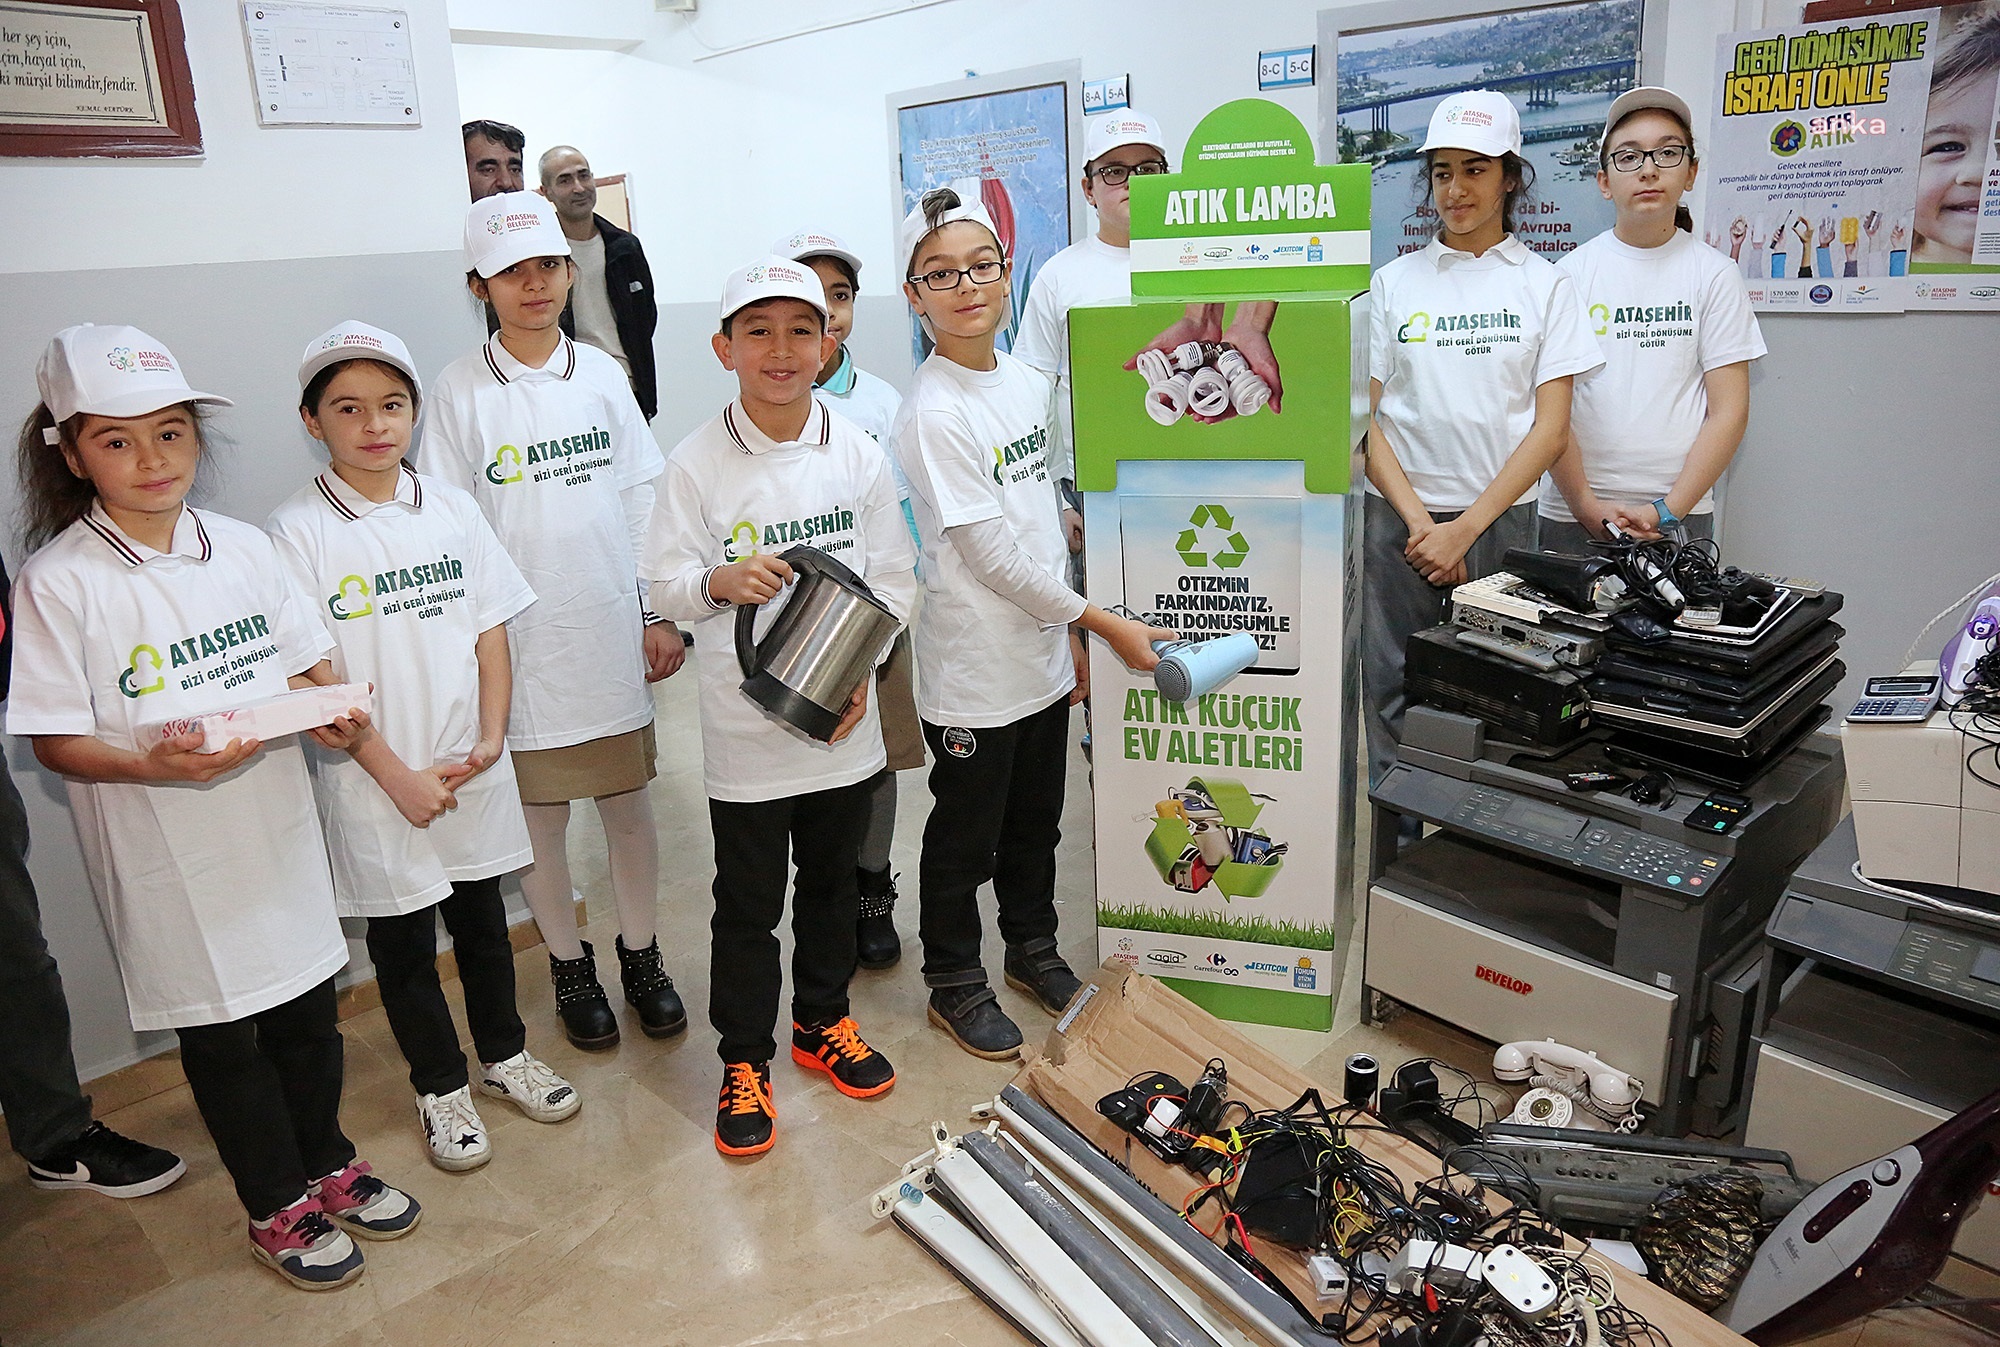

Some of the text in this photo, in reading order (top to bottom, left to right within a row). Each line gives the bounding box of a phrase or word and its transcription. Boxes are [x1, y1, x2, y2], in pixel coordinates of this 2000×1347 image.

[2, 27, 71, 50] her şey için,
[1735, 21, 1928, 76] GERİ DÖNÜŞÜMLE
[60, 53, 86, 71] için,
[1262, 61, 1308, 75] 8-C 5-C
[14, 71, 52, 90] mürşit
[1723, 62, 1891, 116] İSRAFI ÖNLE
[1085, 88, 1124, 102] 8-A 5-A
[1777, 160, 1842, 171] Gelecek nesillere
[1718, 174, 1758, 185] yaşanabilir
[1759, 172, 1769, 181] bir
[1771, 172, 1794, 182] dünya
[1796, 170, 1831, 179] bırakmak
[1833, 168, 1847, 178] için
[1871, 165, 1904, 177] önlüyor,
[1736, 177, 1884, 191] atıklarımızı kaynağında ayrı toplayarak
[1988, 179, 1999, 187] ve
[1164, 183, 1336, 225] ATIK LAMBA
[1767, 190, 1847, 201] geri dönüştürüyoruz.
[1541, 201, 1560, 213] bi-
[1519, 221, 1572, 236] Avrupa
[1435, 308, 1521, 334] ATAŞEHİR
[1614, 300, 1692, 328] ATAŞEHİR
[1437, 333, 1521, 347] BİZİ GERİ DÖNÜŞÜME
[1616, 328, 1692, 339] BİZİ GERİ DÖNÜŞÜME
[1465, 345, 1491, 355] GÖTÜR
[1640, 340, 1666, 348] GÖTÜR
[527, 426, 611, 465] ATAŞEHİR
[533, 469, 551, 483] BİZİ
[553, 463, 573, 478] GERİ
[566, 473, 592, 487] GÖTÜR
[764, 505, 854, 545] ATAŞEHİR
[375, 554, 463, 596] ATAŞEHİR
[1177, 575, 1249, 593] OTİZMİN
[383, 601, 401, 615] BİZİ
[404, 595, 426, 610] GERİ
[1155, 594, 1273, 612] FARKINDAYIZ,
[418, 606, 444, 620] GÖTÜR
[180, 673, 205, 691] BİZİ
[207, 662, 231, 683] GERİ
[223, 669, 256, 690] GÖTÜR
[1123, 688, 1302, 732] ATIK KÜÇÜK
[1123, 727, 1303, 771] EV ALETLERİ
[1255, 962, 1289, 973] EXITCOM
[1295, 967, 1316, 976] TOHUM
[1475, 964, 1534, 995] DEVELOP
